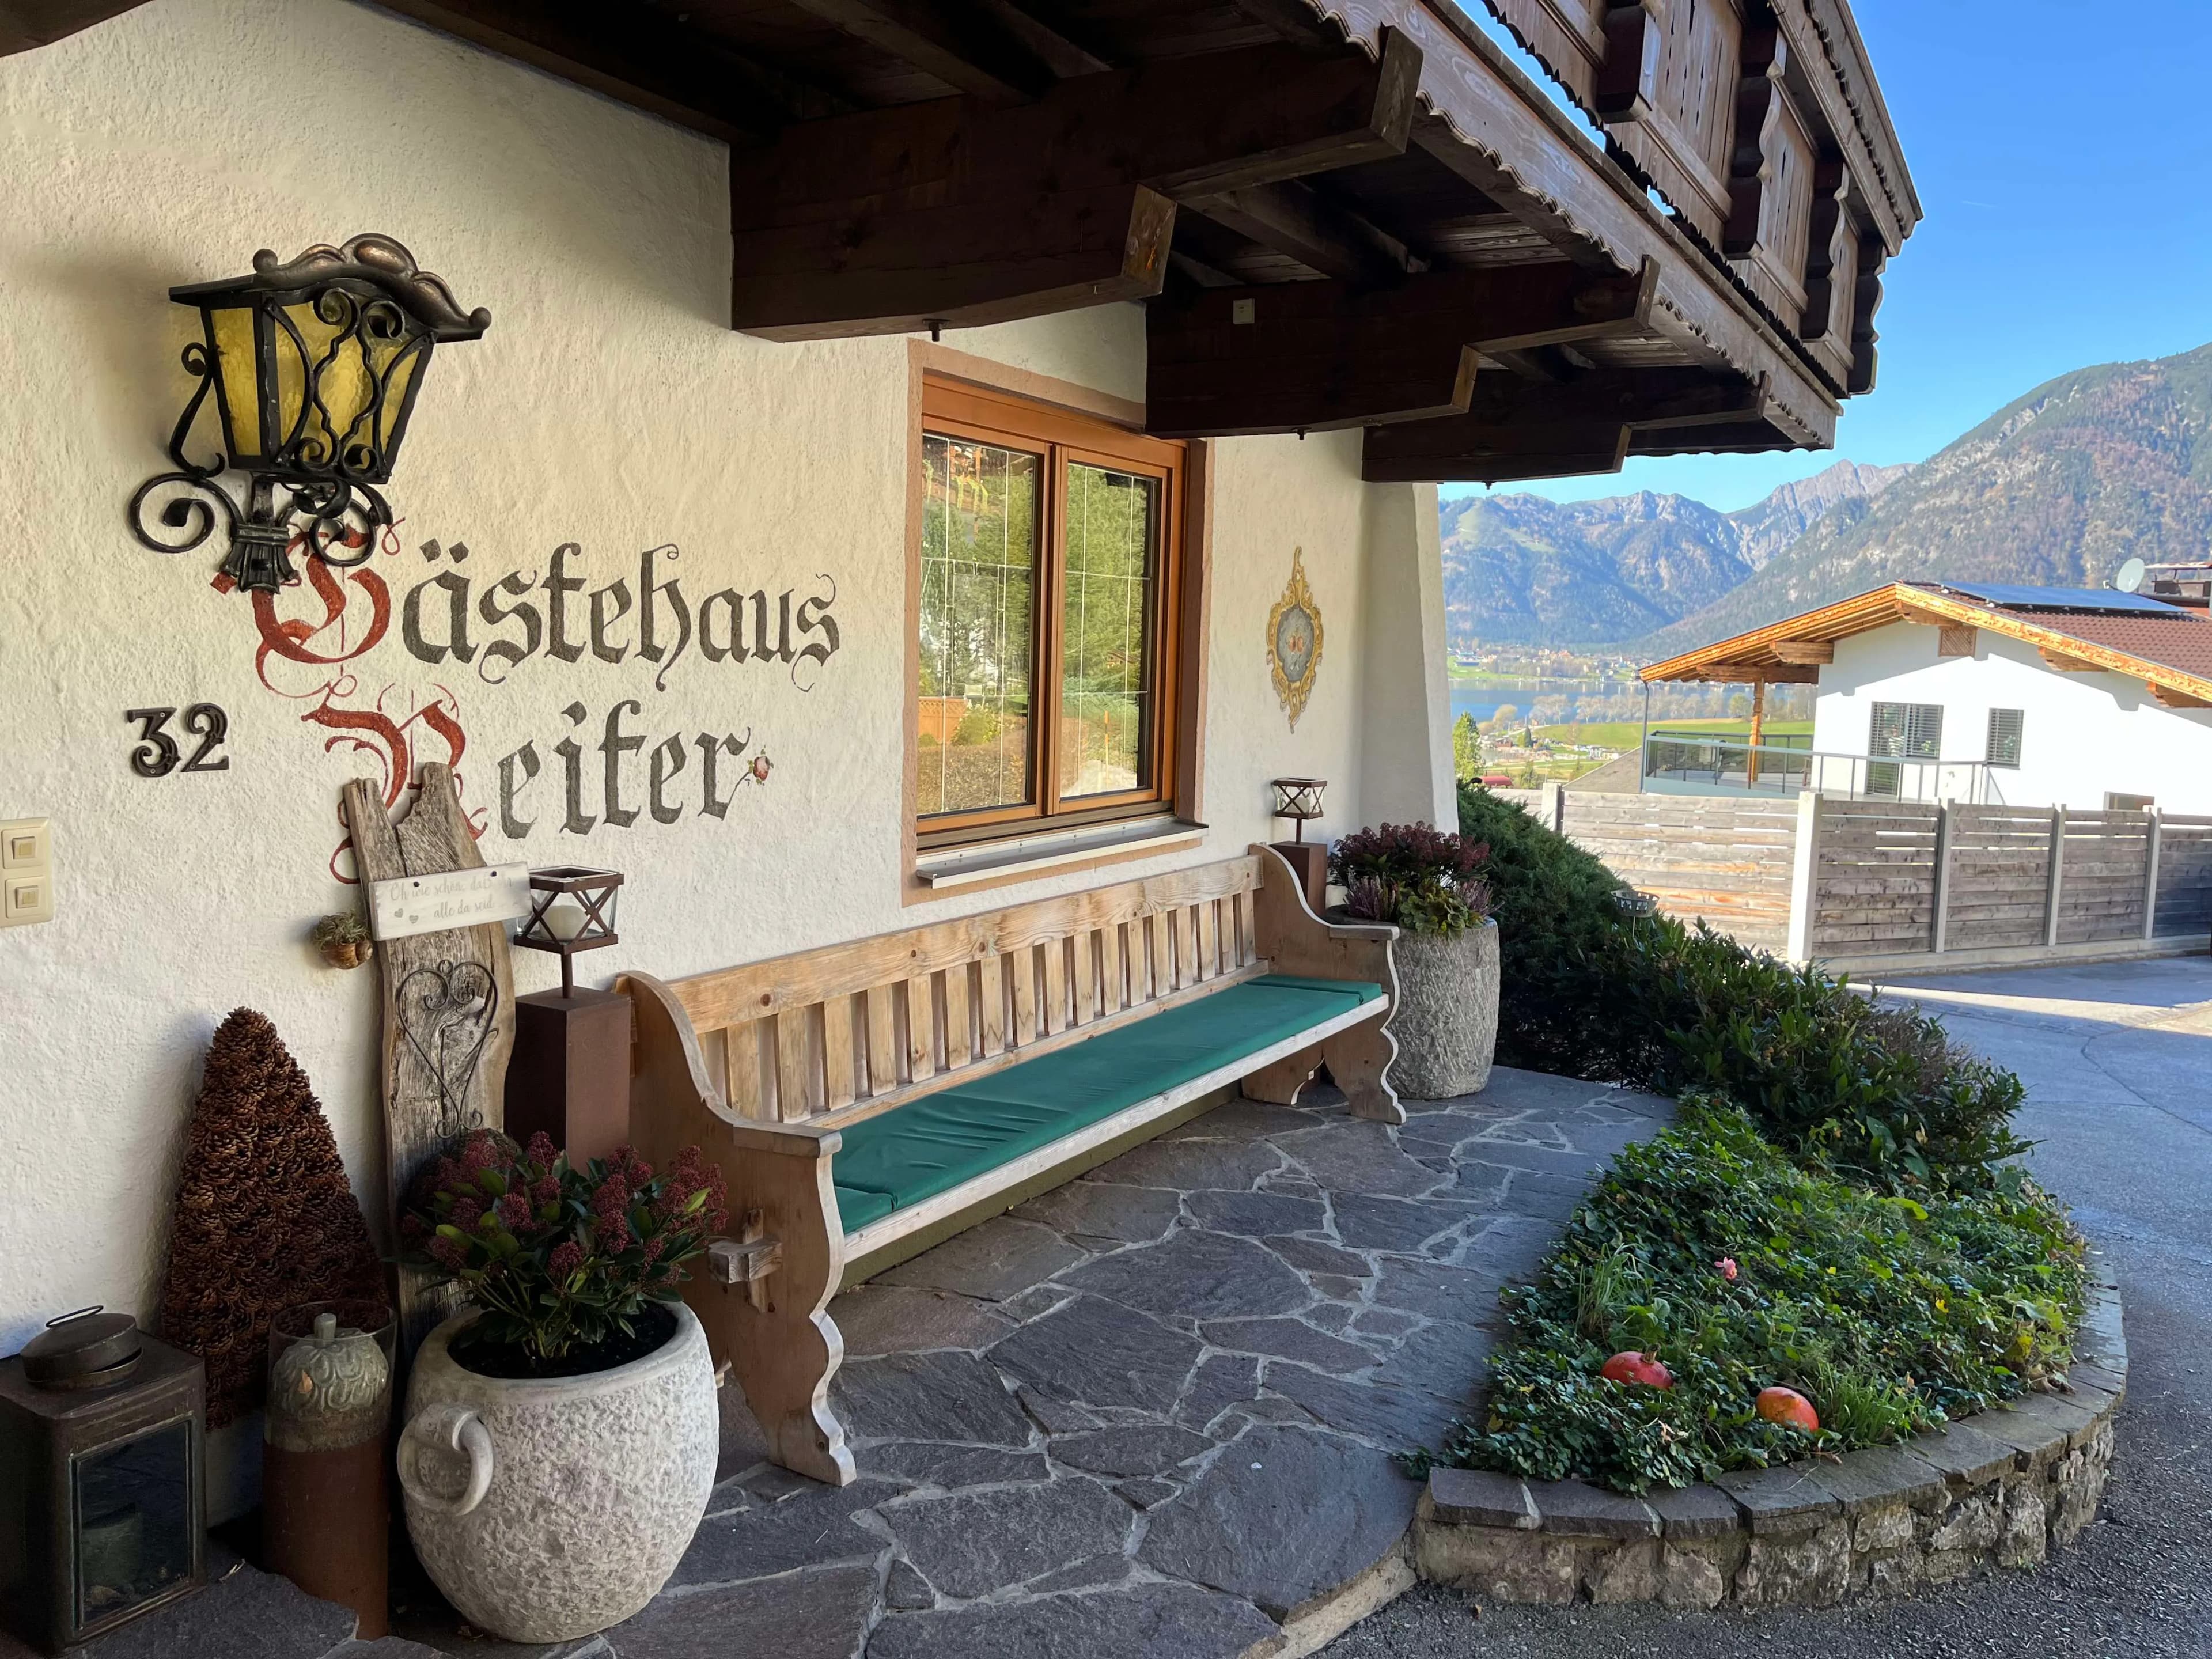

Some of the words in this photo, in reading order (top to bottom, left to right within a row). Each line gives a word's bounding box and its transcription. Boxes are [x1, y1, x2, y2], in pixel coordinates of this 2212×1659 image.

[127, 702, 229, 778] 32
[391, 882, 408, 901] Oh
[412, 886, 430, 898] wie
[434, 900, 455, 919] alle
[457, 899, 470, 914] da
